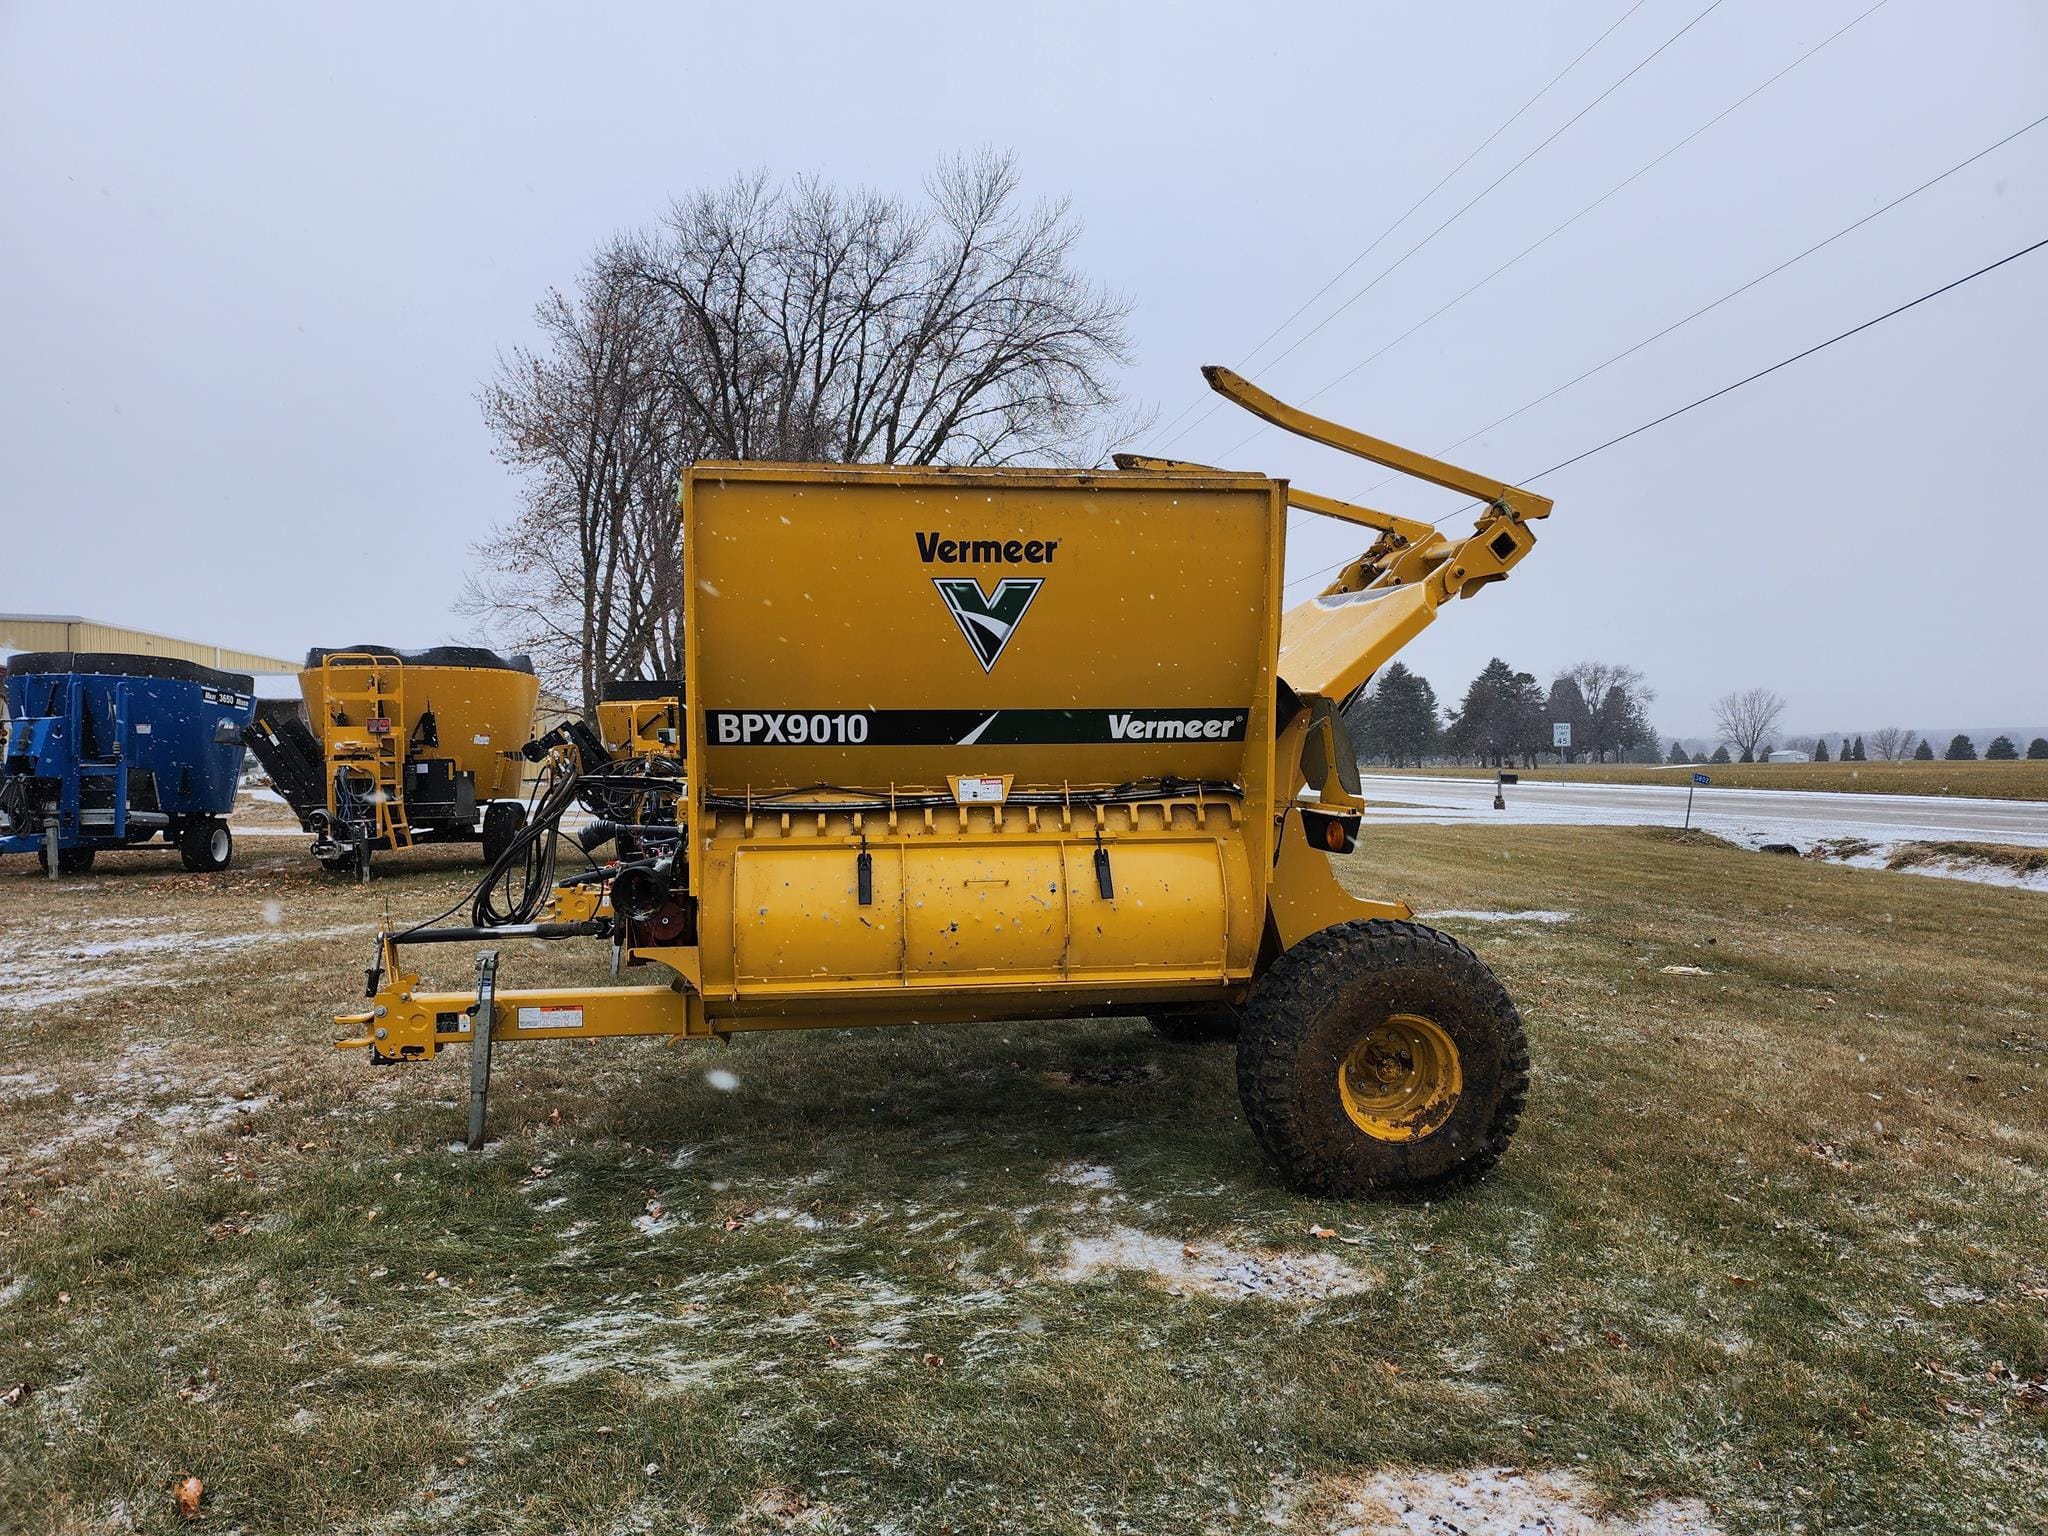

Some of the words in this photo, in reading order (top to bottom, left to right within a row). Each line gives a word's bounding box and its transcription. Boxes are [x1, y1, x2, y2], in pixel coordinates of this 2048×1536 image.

[915, 532, 1058, 563] Vermeer
[219, 693, 234, 705] 3650
[717, 713, 869, 743] BPX9010
[1108, 714, 1235, 739] Vermeer
